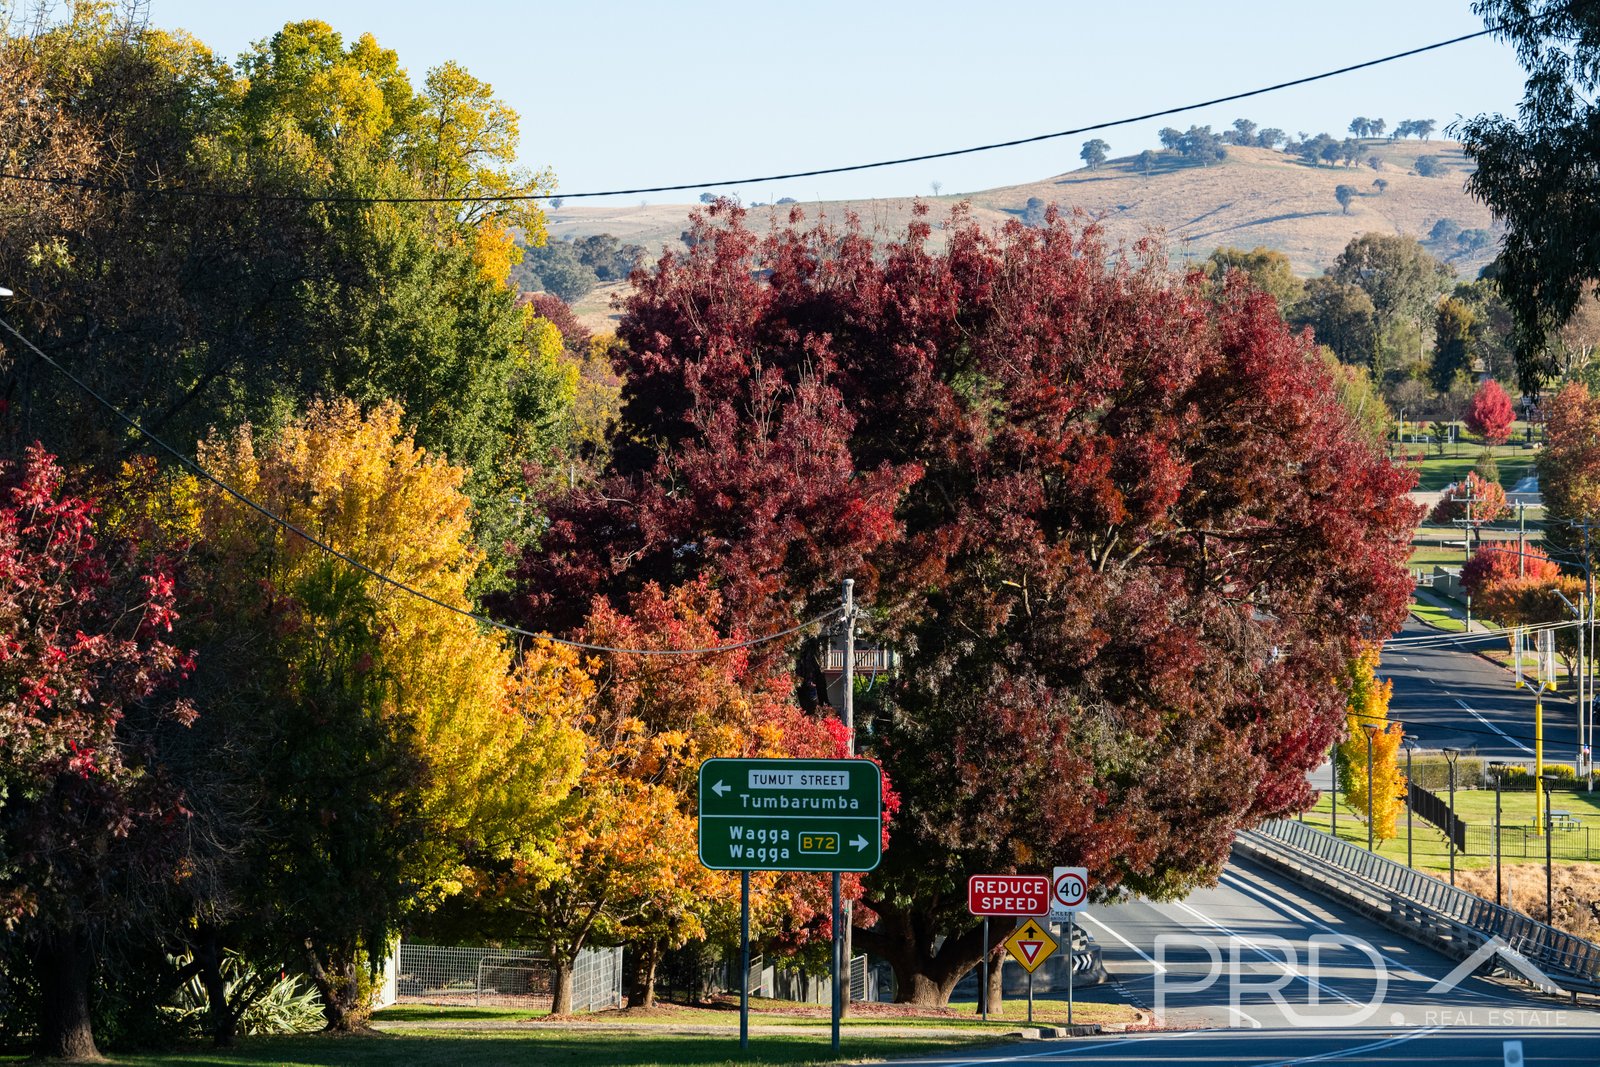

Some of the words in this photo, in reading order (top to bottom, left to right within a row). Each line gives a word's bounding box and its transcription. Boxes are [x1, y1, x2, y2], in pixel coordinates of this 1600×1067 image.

[752, 774, 794, 785] TUMUT
[800, 775, 845, 786] STREET
[739, 794, 859, 810] Tumbarumba
[729, 826, 790, 844] Wagga
[803, 837, 835, 850] B72
[729, 844, 790, 863] Wagga
[975, 881, 1044, 895] REDUCE
[1059, 882, 1081, 897] 40
[981, 897, 1038, 910] SPEED
